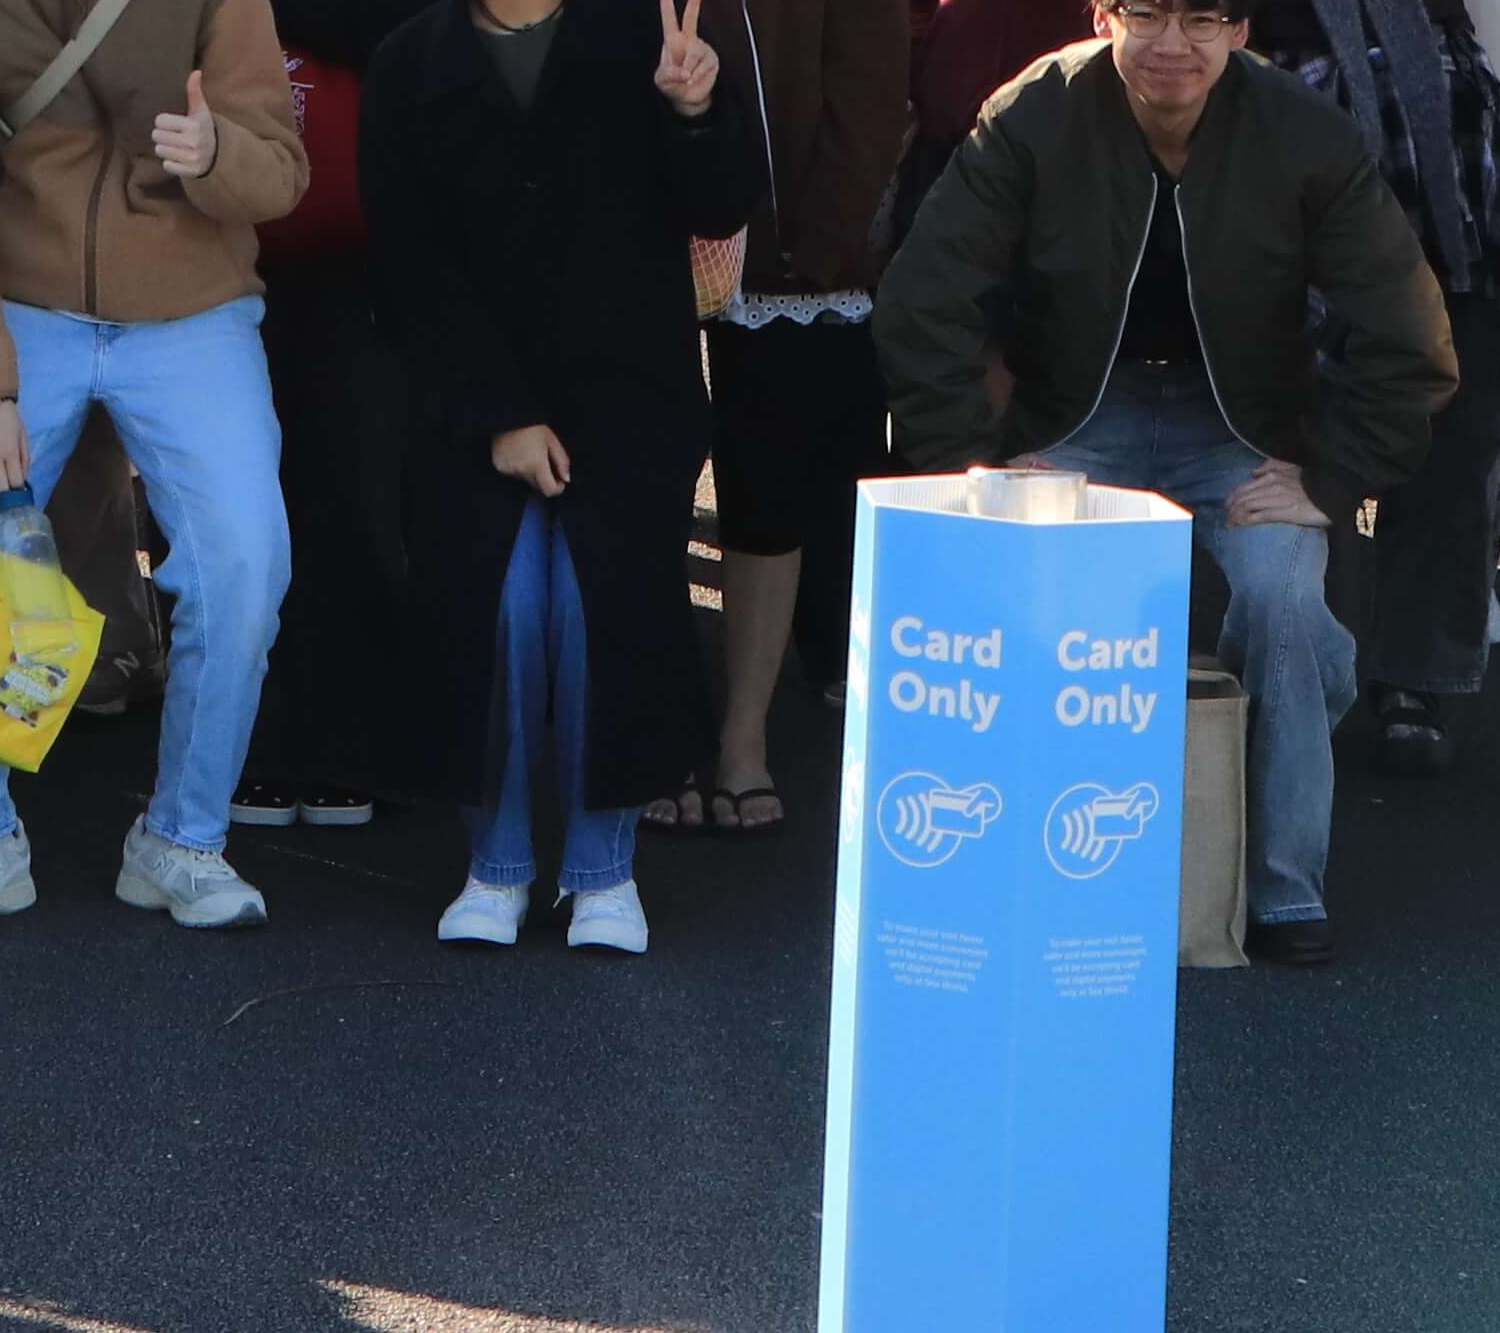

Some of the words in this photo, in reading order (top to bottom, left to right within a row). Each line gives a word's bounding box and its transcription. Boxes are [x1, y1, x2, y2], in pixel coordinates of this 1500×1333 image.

[890, 615, 1002, 669] Card
[1056, 627, 1159, 671] Card
[889, 671, 1000, 733] Only
[1055, 684, 1157, 734] Only
